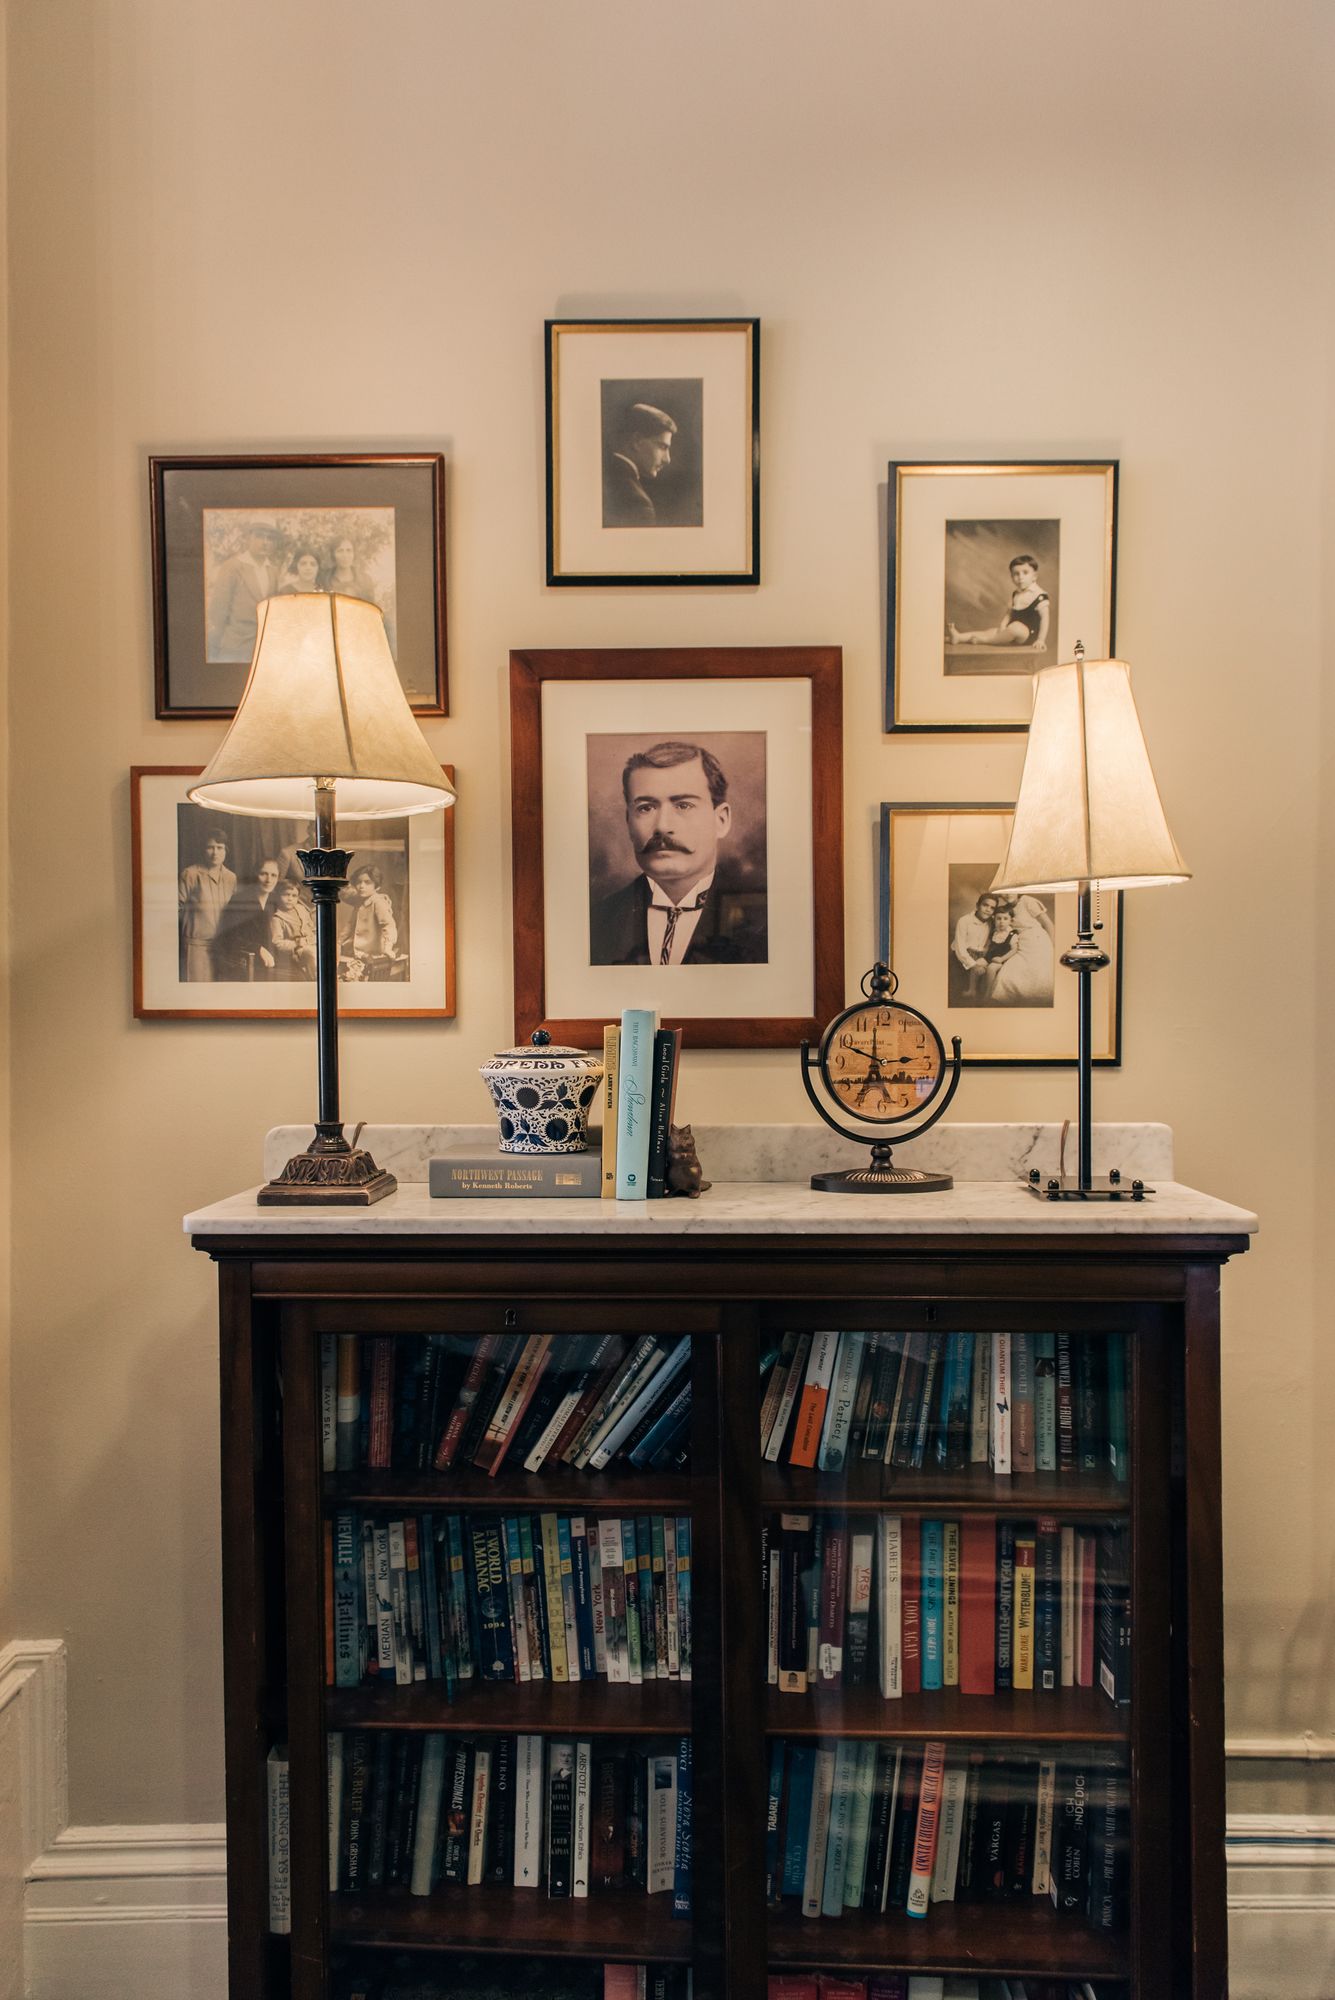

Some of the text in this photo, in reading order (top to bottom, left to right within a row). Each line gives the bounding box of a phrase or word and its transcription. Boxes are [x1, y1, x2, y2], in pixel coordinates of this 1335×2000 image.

[857, 1018, 867, 1032] 11
[876, 1010, 891, 1026] 12
[902, 1018, 907, 1033] 1
[606, 1036, 618, 1071] LIMITS
[840, 1034, 853, 1049] 10
[916, 1034, 926, 1049] 2
[836, 1055, 846, 1070] 9
[923, 1055, 931, 1071] 3
[623, 1074, 646, 1137] Showdown
[656, 1043, 672, 1154] Local Girls Alice Hoffman
[877, 1099, 887, 1113] 6
[899, 1093, 909, 1108] 5
[452, 1169, 543, 1181] NORTHWEST PASSAGE
[505, 1182, 532, 1190] Roberts
[628, 1334, 657, 1372] LIMITS
[816, 1333, 830, 1371] Lesley Downer
[844, 1341, 856, 1371] RACHEL
[1058, 1350, 1070, 1388] CORNWELL
[1018, 1353, 1026, 1392] PICOULT
[806, 1412, 815, 1424] Last
[808, 1401, 817, 1413] The
[830, 1397, 850, 1441] Perfect
[1060, 1406, 1071, 1430] FRONT
[540, 1398, 576, 1453] THOMAS JEFFERSON
[576, 1539, 584, 1552] New
[948, 1529, 956, 1545] THE
[376, 1532, 388, 1580] New York
[472, 1530, 490, 1594] ALMANAC
[486, 1536, 502, 1585] WORLD
[888, 1531, 898, 1582] DIABETES
[948, 1547, 956, 1572] SILVER
[337, 1516, 355, 1659] NEVILLE Ratlines
[577, 1570, 587, 1605] Pennsylvania
[628, 1581, 636, 1602] Atlantic
[860, 1567, 870, 1600] YRSA
[947, 1575, 956, 1605] LININGS
[591, 1582, 604, 1633] New York
[998, 1559, 1011, 1668] DEALING FUTURES
[1044, 1548, 1053, 1663] FORESTS OF THE NIGHT
[379, 1618, 391, 1660] MERIAN
[904, 1600, 918, 1659] LOOK AGAIN
[926, 1616, 937, 1634] JOHN
[1020, 1634, 1028, 1650] DIRIE
[927, 1636, 937, 1660] GREEN
[1019, 1652, 1028, 1672] WARIS
[450, 1752, 467, 1810] PROFESSIONALS
[477, 1773, 485, 1792] Agatha
[577, 1752, 586, 1797] ARISTOTLE
[841, 1766, 850, 1781] THE
[878, 1755, 892, 1825] MICHAEL ONDAATJE
[476, 1793, 484, 1814] Christie
[495, 1739, 508, 1857] INFERNO DAN BROWN
[766, 1794, 778, 1831] TABARLY
[838, 1783, 849, 1811] LIVING
[945, 1777, 958, 1835] JODI PICOULT
[1063, 1796, 1075, 1816] ICH
[278, 1772, 288, 1874] THE KING OF YS
[348, 1779, 363, 1877] BRIEF JOHN GRISHAM
[658, 1816, 667, 1859] SURVIVOR
[680, 1790, 693, 1873] Nova Scotia
[916, 1807, 935, 1843] BARBARA
[988, 1819, 1001, 1861] VARGAS
[444, 1836, 453, 1867] LAUKKANEN
[452, 1844, 460, 1861] OWEN
[790, 1844, 806, 1885] Cecelia
[913, 1843, 932, 1873] RASKIN
[1061, 1845, 1074, 1880] HARLAN
[1071, 1847, 1082, 1879] COBEN
